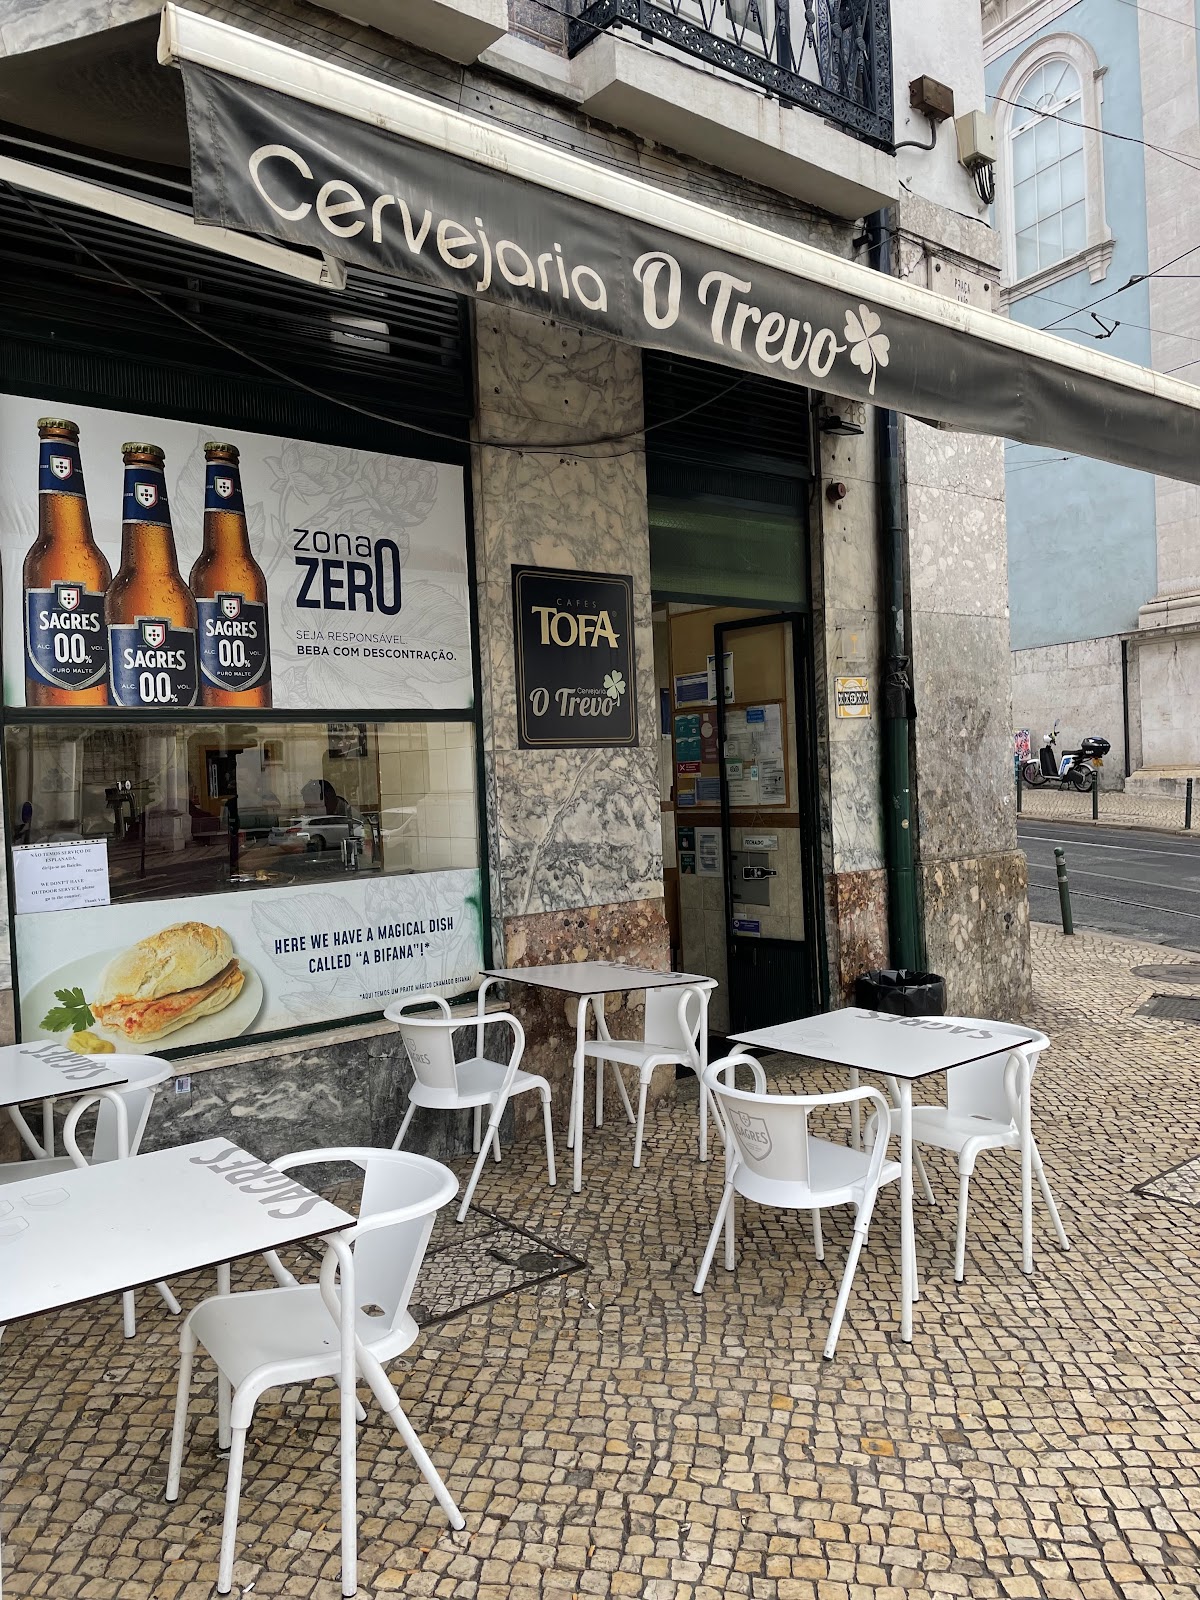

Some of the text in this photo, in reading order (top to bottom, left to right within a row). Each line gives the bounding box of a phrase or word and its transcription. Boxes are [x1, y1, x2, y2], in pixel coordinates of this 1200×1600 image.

[248, 143, 847, 379] Cervejaria O Trevo
[844, 404, 867, 425] 48
[293, 528, 372, 558] zona
[295, 538, 402, 616] ZERO
[39, 610, 101, 632] SAGRES
[205, 618, 258, 639] SAGRES
[531, 605, 621, 649] TOFA
[296, 630, 408, 645] SEJA RESPONSÁVEL.
[123, 648, 187, 671] SAGRES
[297, 645, 457, 661] BEBA COM DESCONTRAÇÃO.
[529, 687, 618, 717] O Trevo
[576, 686, 607, 696] Cervejaria
[275, 916, 454, 955] HERE WE HAVE A MAGICAL DISH
[308, 953, 352, 974] CALLED
[374, 989, 391, 999] TEMOS
[391, 987, 399, 995] UM
[399, 985, 415, 994] PRATO
[415, 981, 433, 991] MÁGICO
[433, 978, 454, 988] CHAMADO
[855, 1010, 993, 1040] SAGRES
[19, 1044, 111, 1081] SAGRES
[735, 1123, 769, 1145] SAGRES
[188, 1146, 322, 1220] SAGRES
